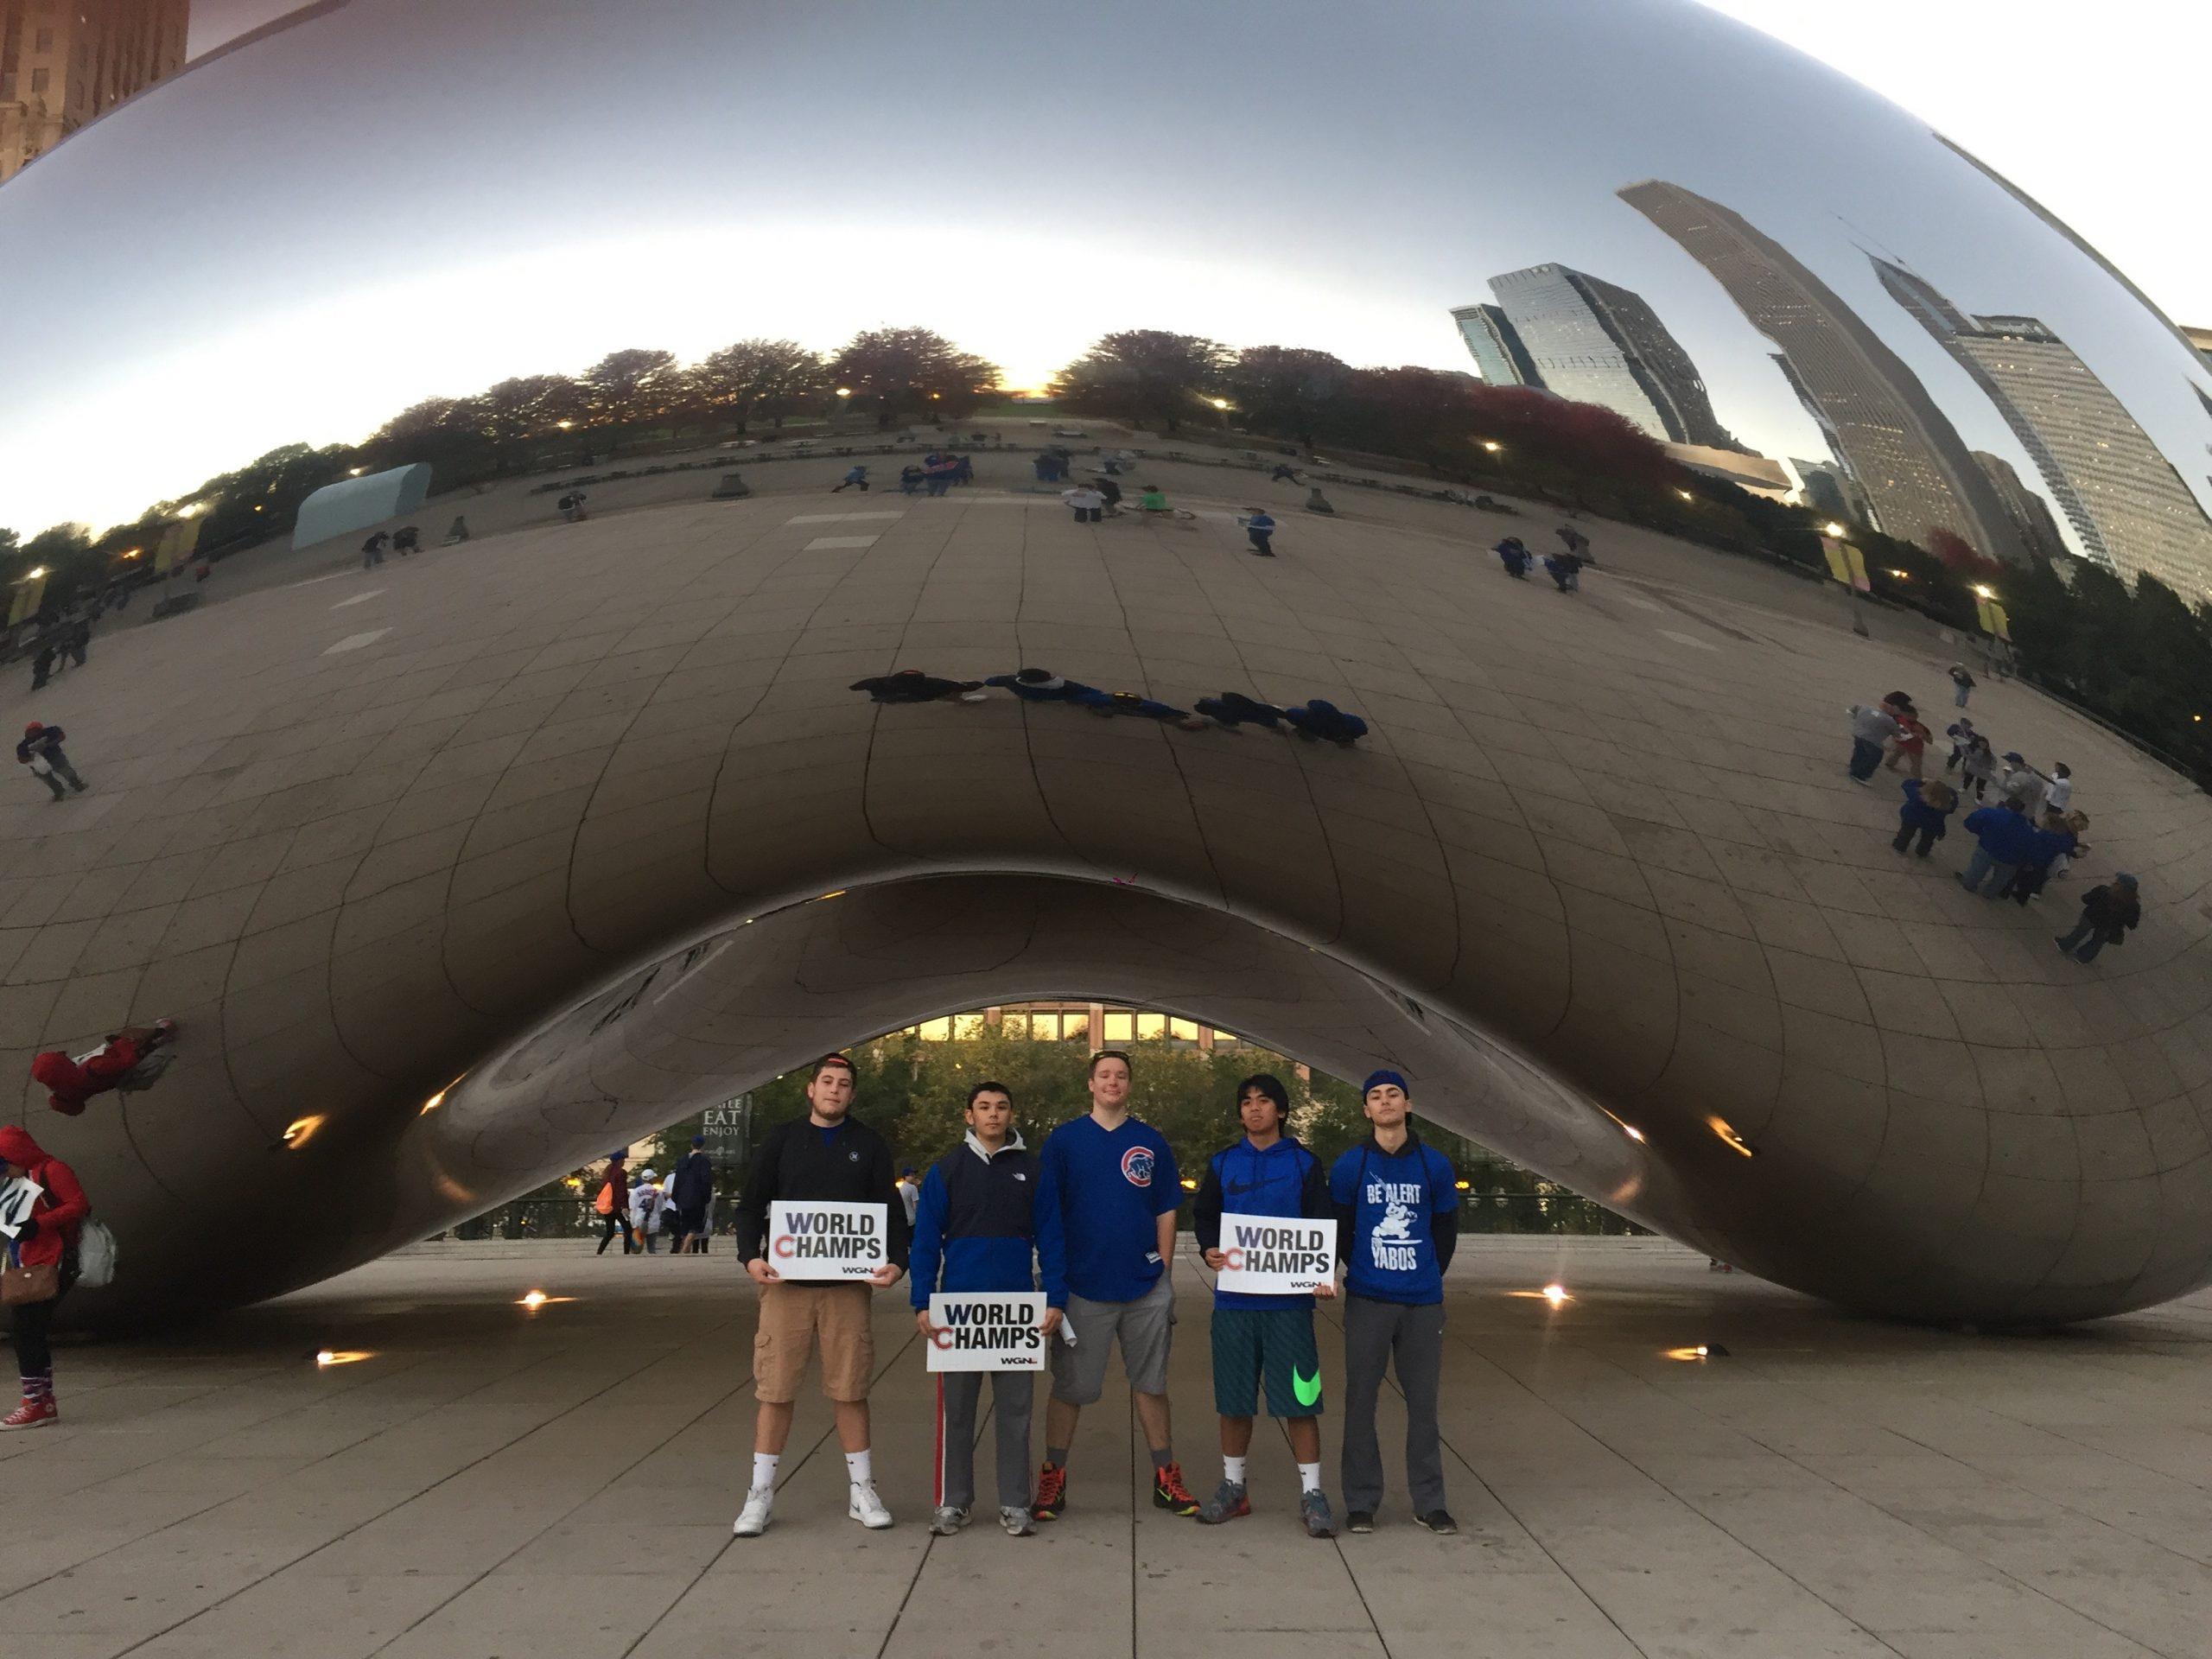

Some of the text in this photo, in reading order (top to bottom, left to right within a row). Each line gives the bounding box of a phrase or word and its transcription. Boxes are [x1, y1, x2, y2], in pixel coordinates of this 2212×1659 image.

[704, 1110, 741, 1125] EAT
[702, 1126, 741, 1137] ENJOY
[1366, 1183, 1421, 1205] BE ALERT
[785, 1212, 874, 1236] WORLD
[774, 1235, 881, 1259] CHAMPS
[1235, 1225, 1324, 1251] WORLD
[1224, 1248, 1330, 1274] CHAMPS
[1371, 1236, 1417, 1271] YABOS
[944, 1303, 1034, 1325] WORLD
[932, 1326, 1040, 1351] CHAMPS
